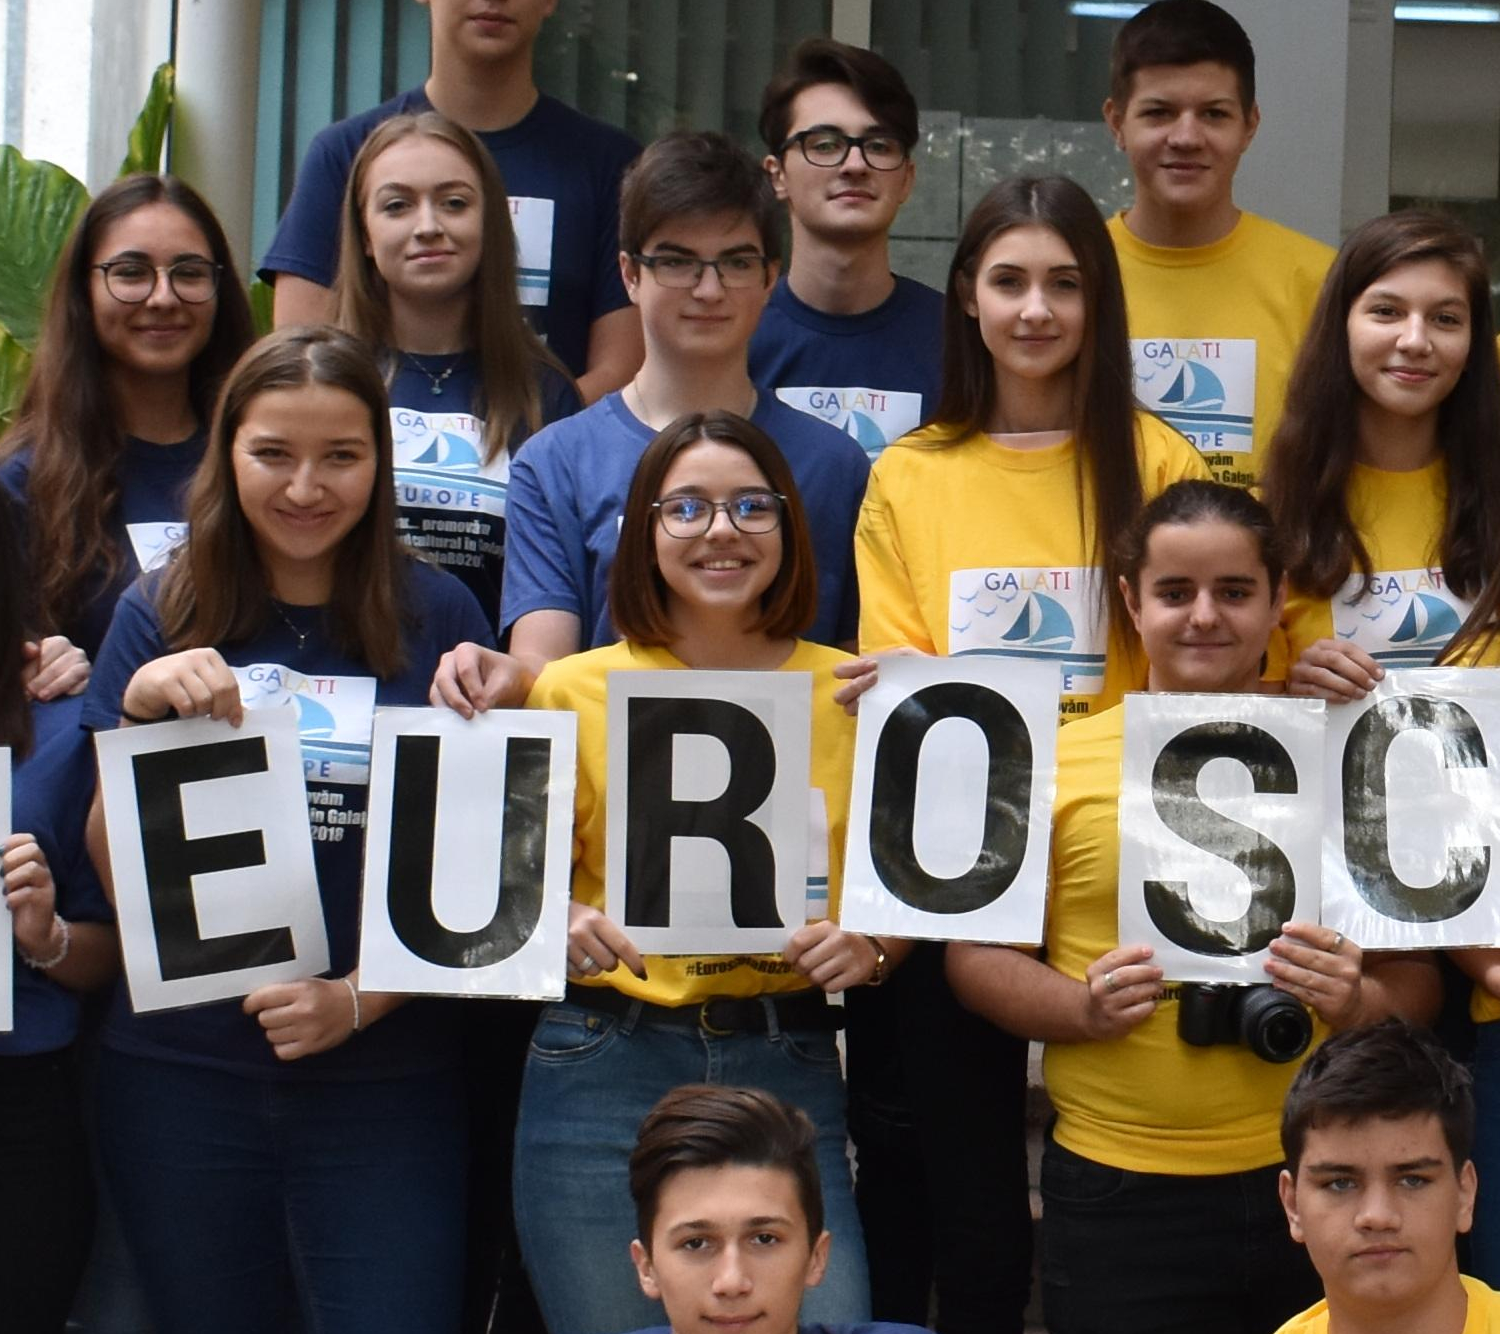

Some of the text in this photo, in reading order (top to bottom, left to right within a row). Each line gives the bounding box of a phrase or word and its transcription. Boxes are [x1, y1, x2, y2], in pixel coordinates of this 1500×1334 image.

[1143, 342, 1220, 359] GALATI
[809, 391, 886, 411] GALATI
[984, 571, 1070, 591] GALATI
[1369, 571, 1442, 595] GALAT
[249, 667, 335, 695] GALATI
